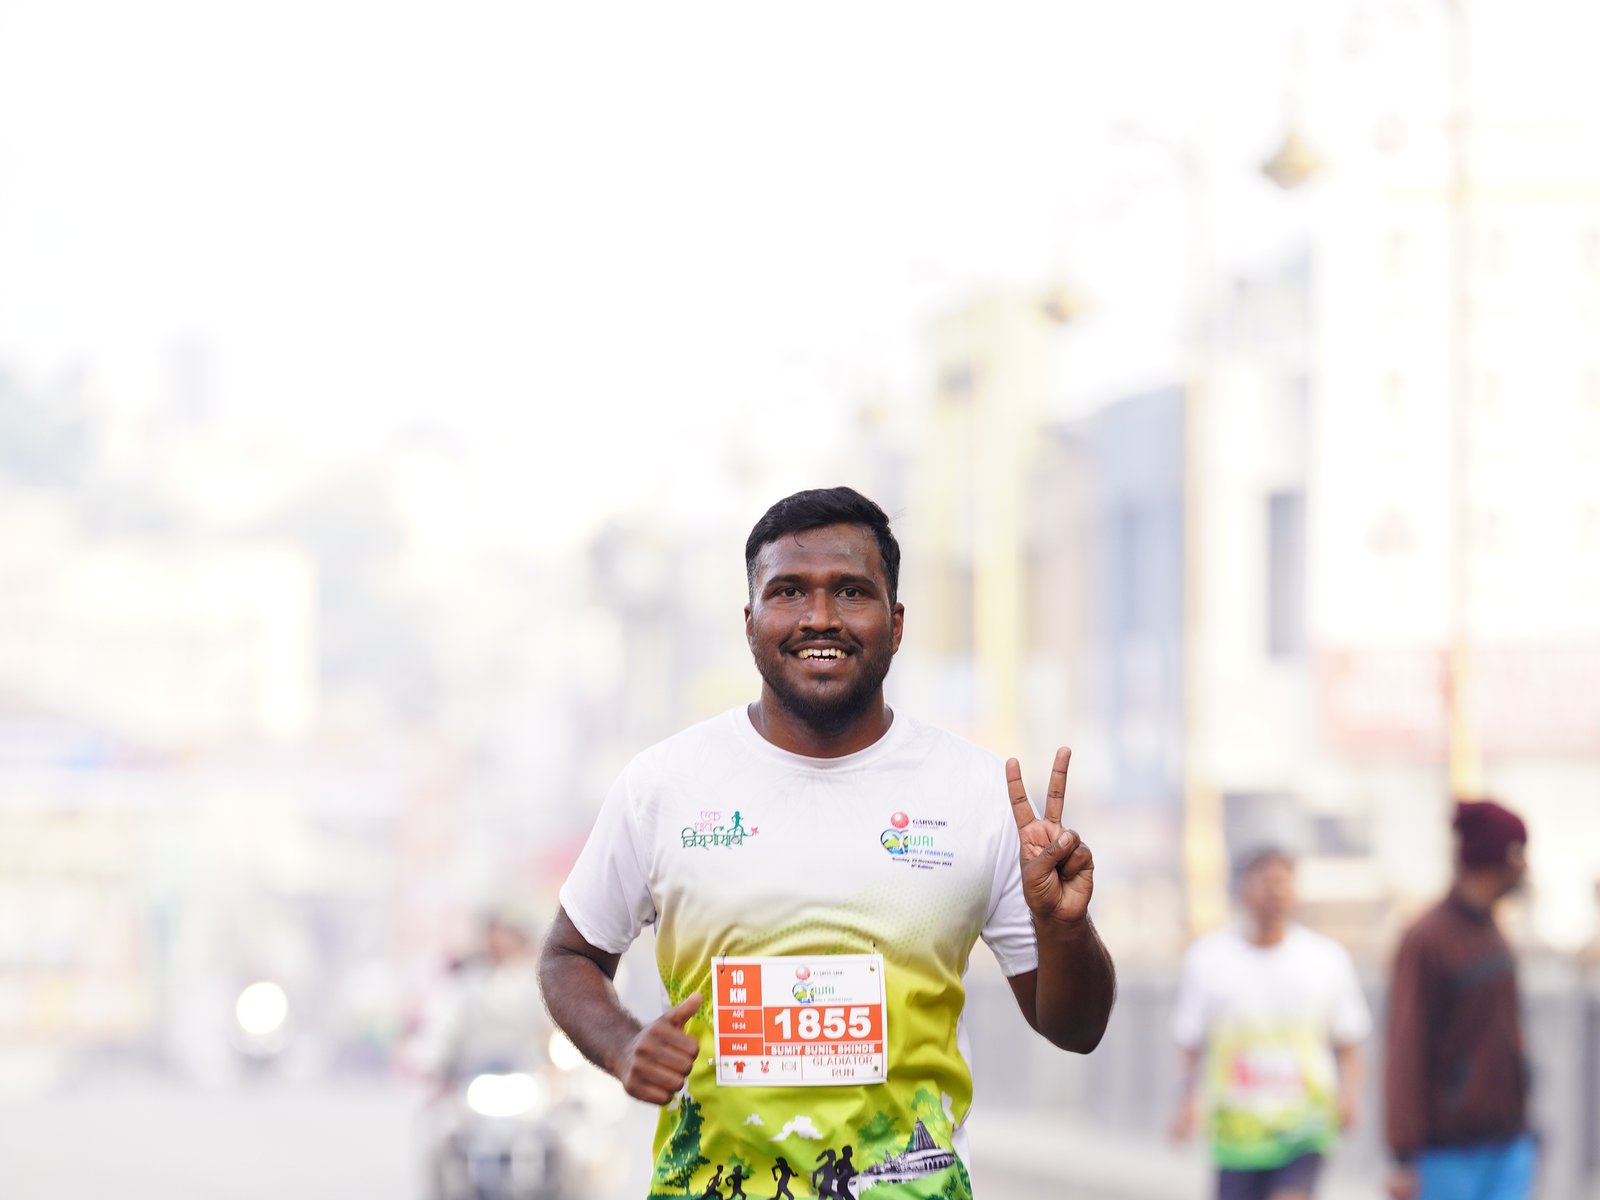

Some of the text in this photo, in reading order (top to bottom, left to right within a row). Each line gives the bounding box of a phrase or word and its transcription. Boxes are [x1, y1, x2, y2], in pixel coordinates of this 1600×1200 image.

[912, 819, 948, 827] GARWARE
[909, 835, 934, 847] WAI
[731, 969, 744, 986] 10
[729, 988, 747, 1004] KM
[732, 1008, 745, 1019] AGE
[774, 1007, 872, 1040] 1855
[731, 1042, 748, 1052] MALE
[771, 1043, 874, 1056] SUMIT SUNIL SHINDE
[812, 1055, 873, 1066] GLADIATOR
[831, 1068, 855, 1078] RUN
